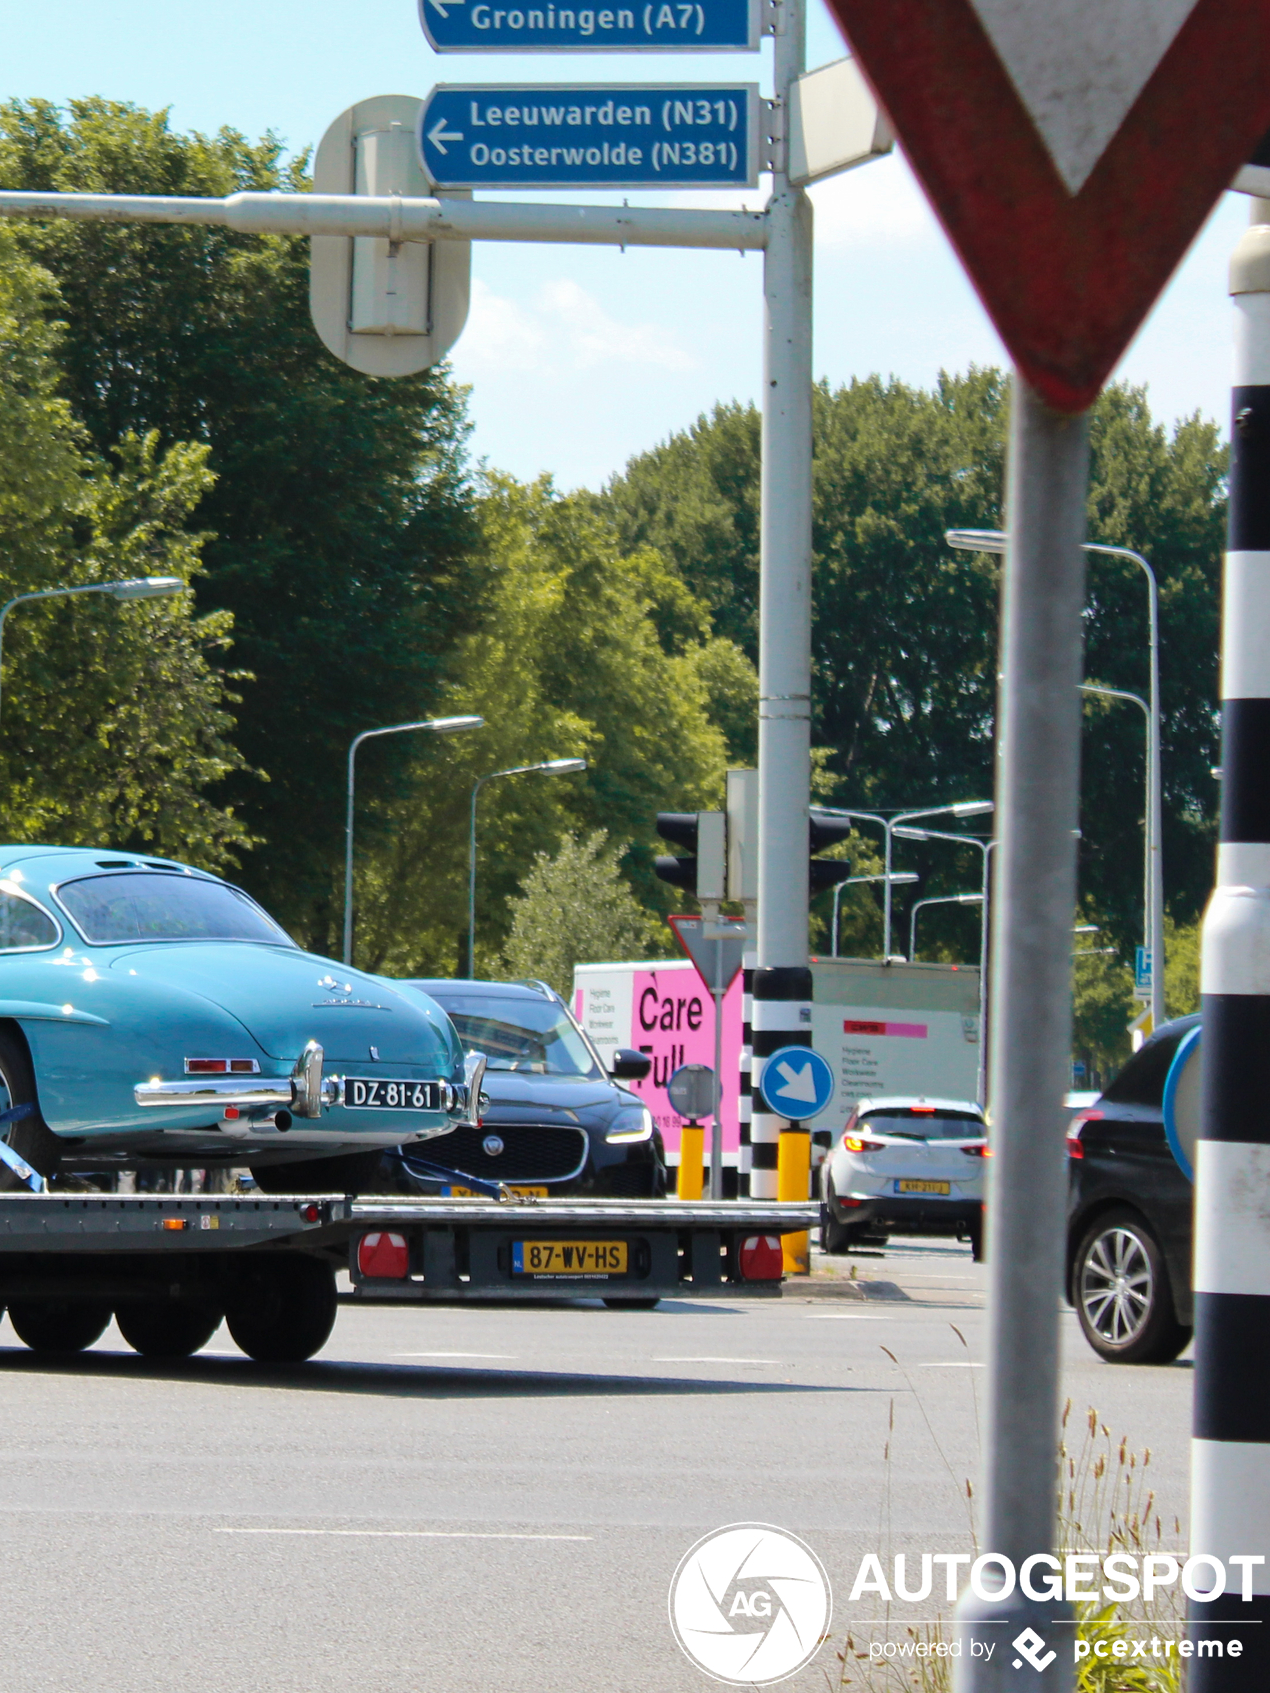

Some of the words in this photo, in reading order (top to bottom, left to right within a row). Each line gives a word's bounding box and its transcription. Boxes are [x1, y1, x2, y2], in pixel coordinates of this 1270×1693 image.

[470, 4, 634, 35] Groningen
[643, 4, 705, 35] (A7)
[470, 101, 651, 127] Leeuwarden
[661, 100, 738, 131] (N31)
[470, 142, 643, 167] Oosterwolde
[651, 141, 738, 171] (N381)
[639, 987, 703, 1031] Care
[529, 1246, 621, 1269] 87-WV-HS
